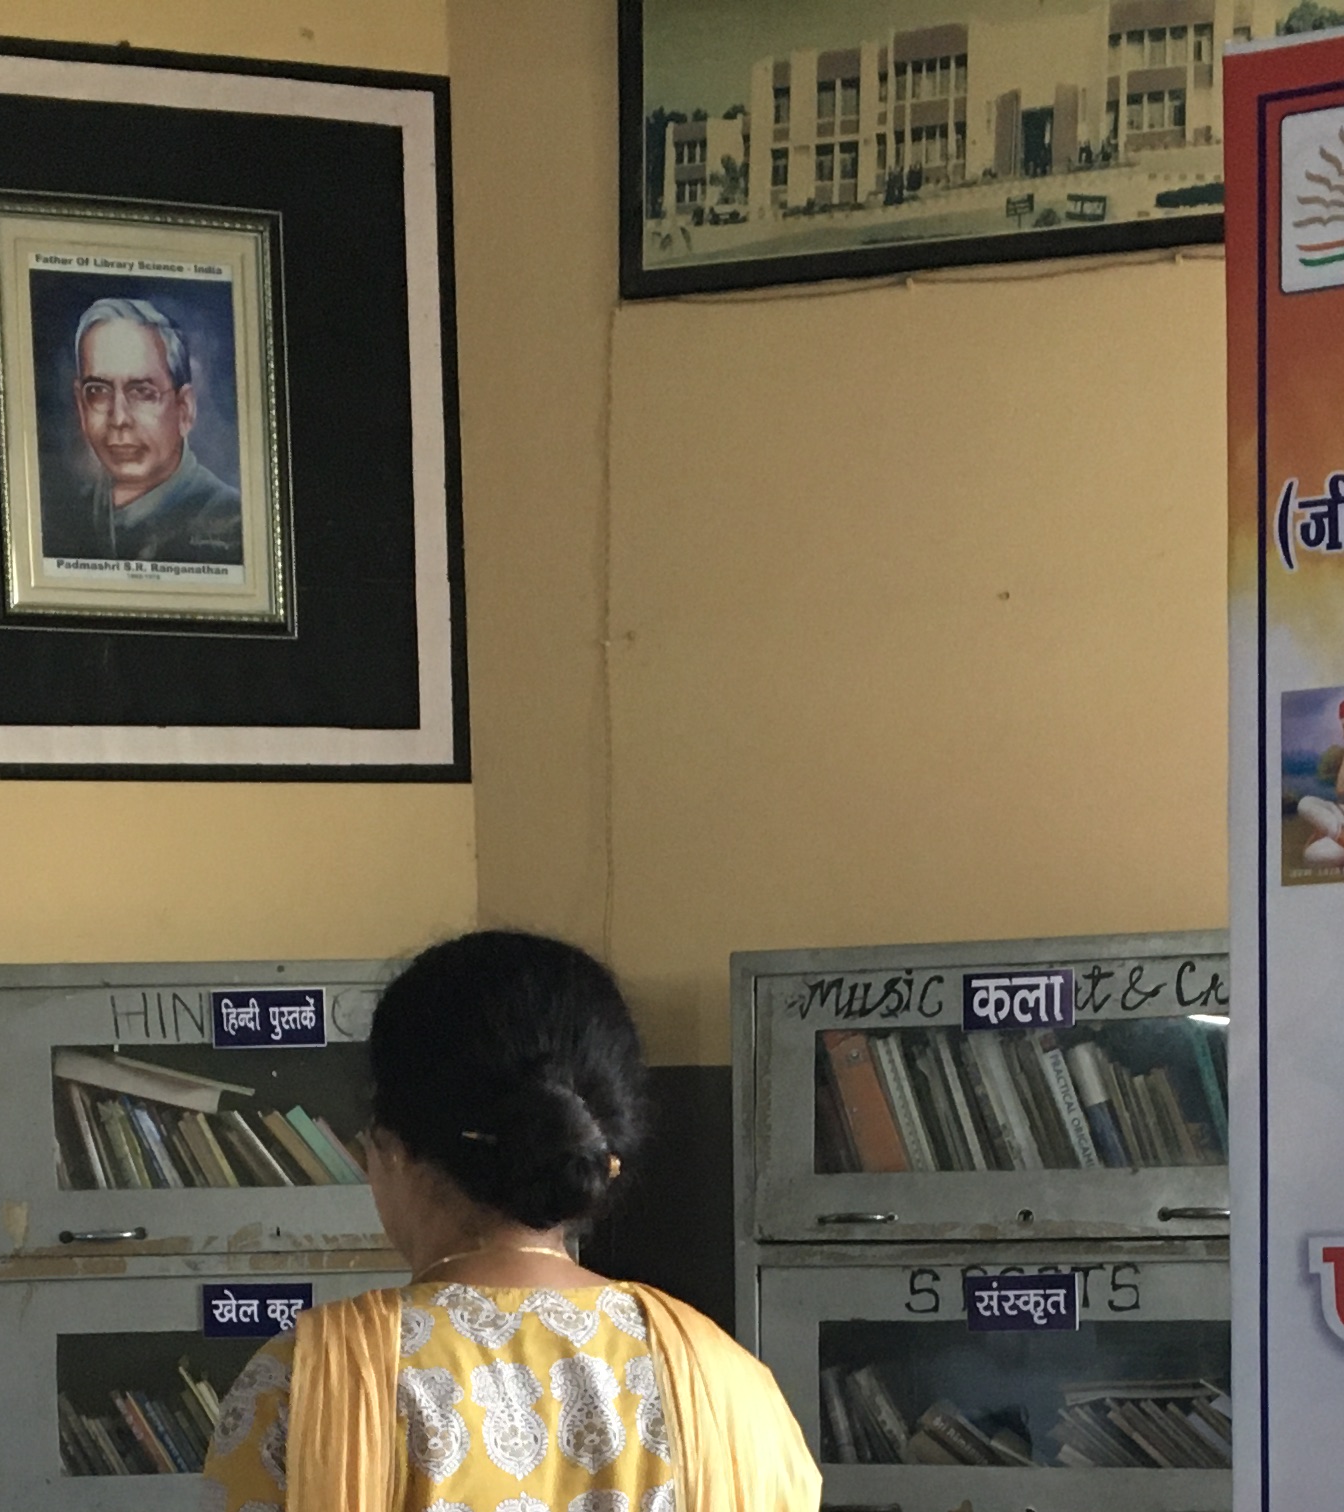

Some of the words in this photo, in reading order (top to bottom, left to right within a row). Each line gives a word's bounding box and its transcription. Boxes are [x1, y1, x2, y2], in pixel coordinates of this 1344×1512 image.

[35, 254, 74, 266] Father
[76, 257, 90, 267] Of
[93, 258, 135, 272] Library
[138, 261, 184, 273] Science
[193, 264, 223, 275] India
[56, 559, 120, 572] Padmashri
[150, 563, 229, 576] Ranganathan
[970, 975, 1065, 1025] कला
[1120, 965, 1167, 1012] &
[220, 998, 260, 1036] हिन्दी
[268, 996, 316, 1041] पुस्तकें
[211, 1289, 260, 1323] खेल
[974, 1280, 1068, 1326] संस्कृत
